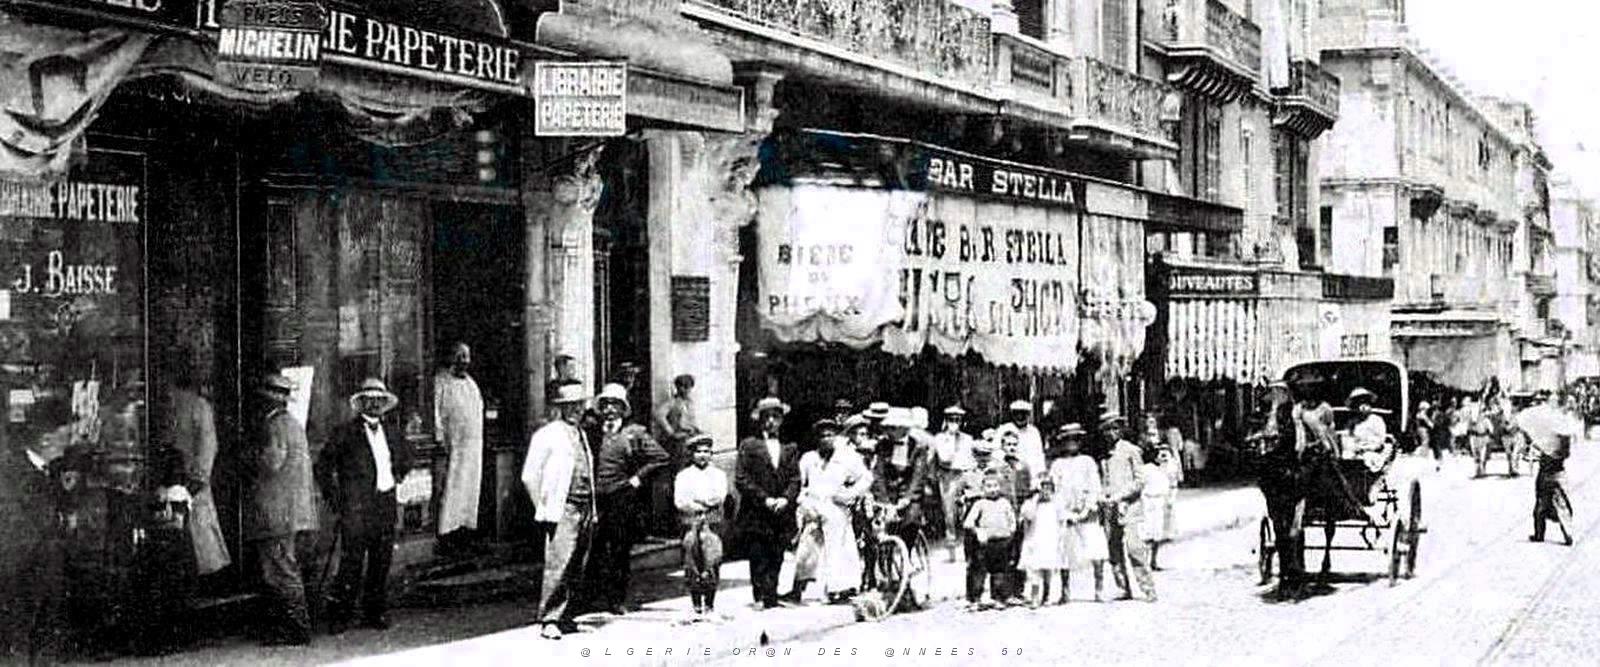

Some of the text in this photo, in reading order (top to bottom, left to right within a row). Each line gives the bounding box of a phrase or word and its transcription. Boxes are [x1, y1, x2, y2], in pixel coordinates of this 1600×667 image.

[219, 27, 320, 60] MICHELIN
[365, 18, 522, 84] PAPETERIE
[57, 181, 139, 222] PAPETERIE
[926, 156, 1076, 204] BAR STELLA
[41, 249, 119, 297] BAISSE
